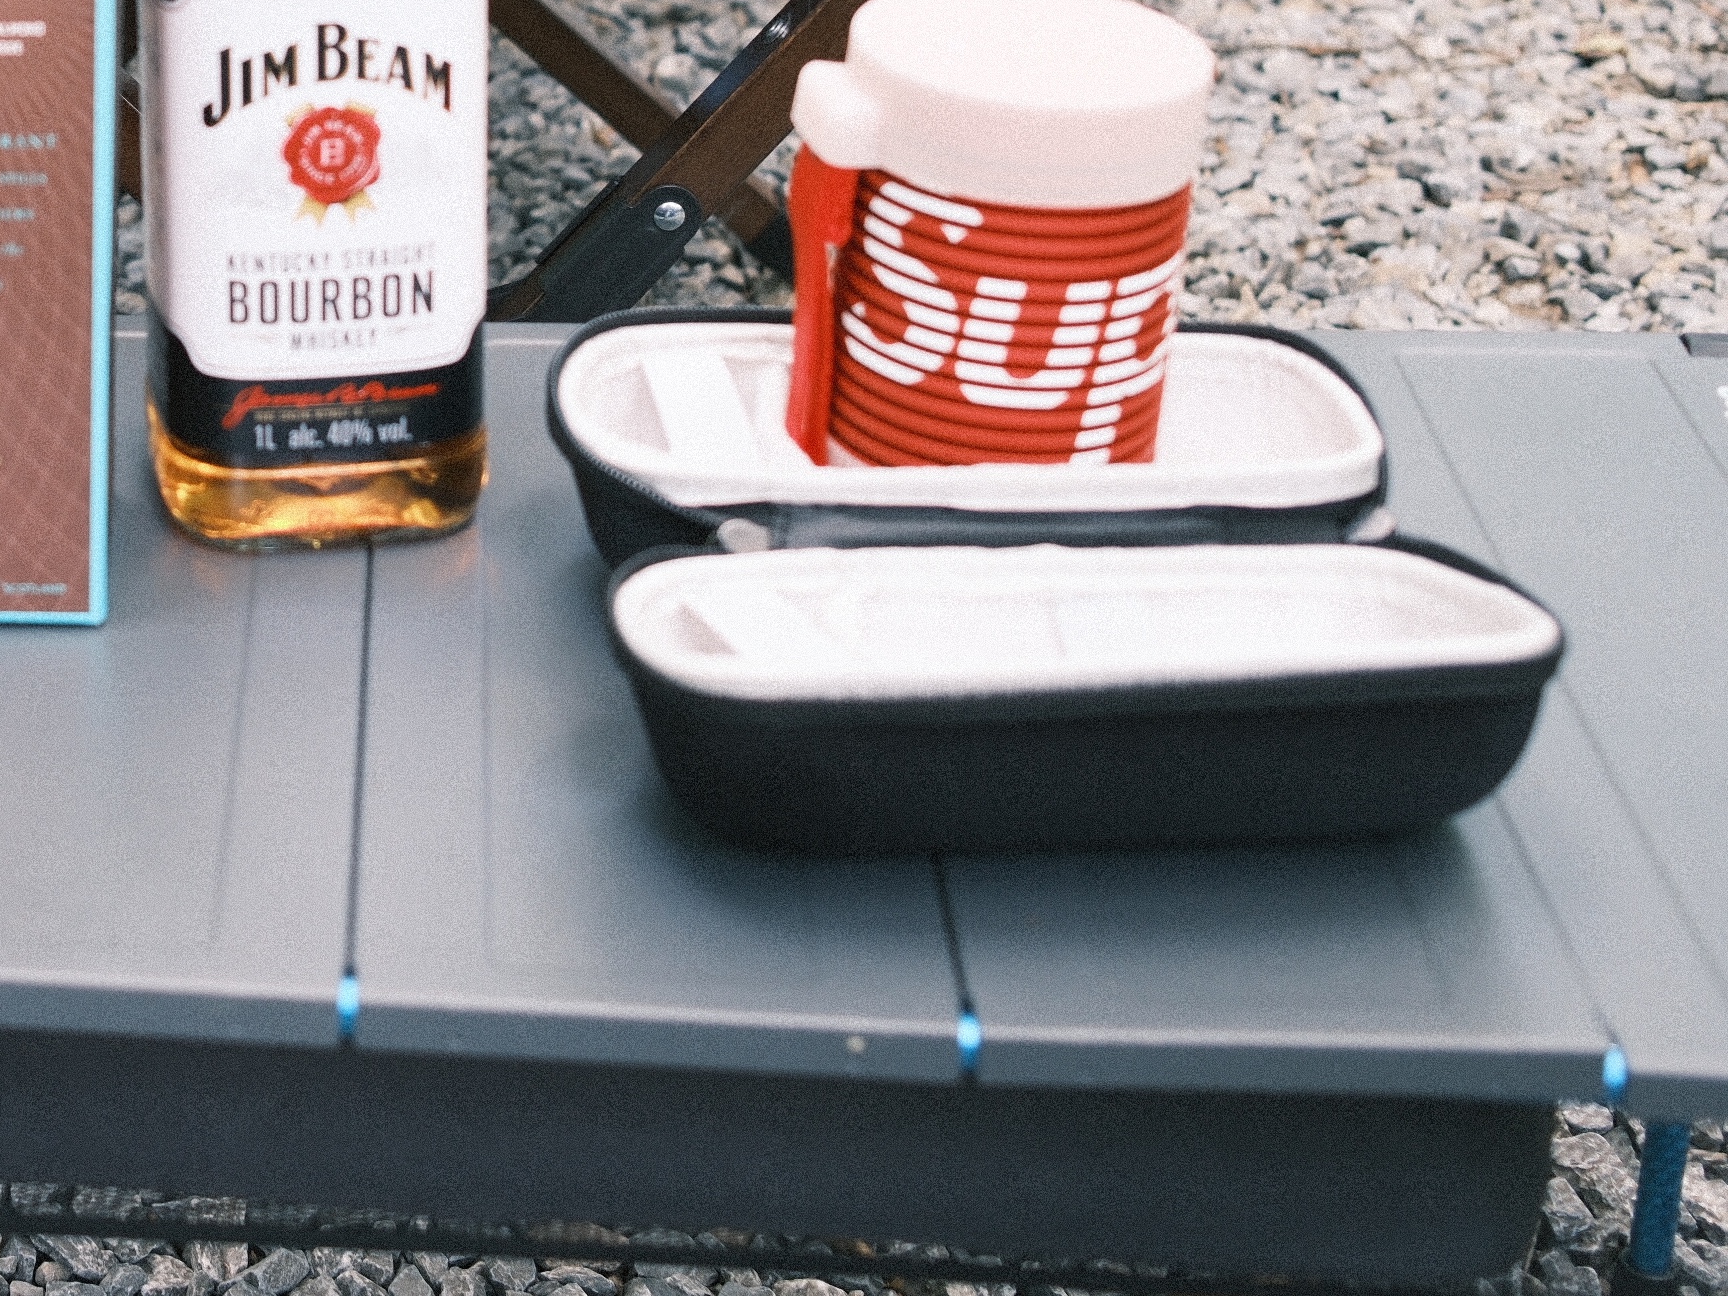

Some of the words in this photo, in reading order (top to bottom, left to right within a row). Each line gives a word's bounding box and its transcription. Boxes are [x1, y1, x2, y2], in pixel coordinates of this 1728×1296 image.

[203, 44, 299, 128] JIM
[317, 23, 453, 112] BEAM
[227, 251, 333, 272] KENTUCKY
[228, 270, 434, 324] BOURBON
[288, 422, 324, 450] alc.
